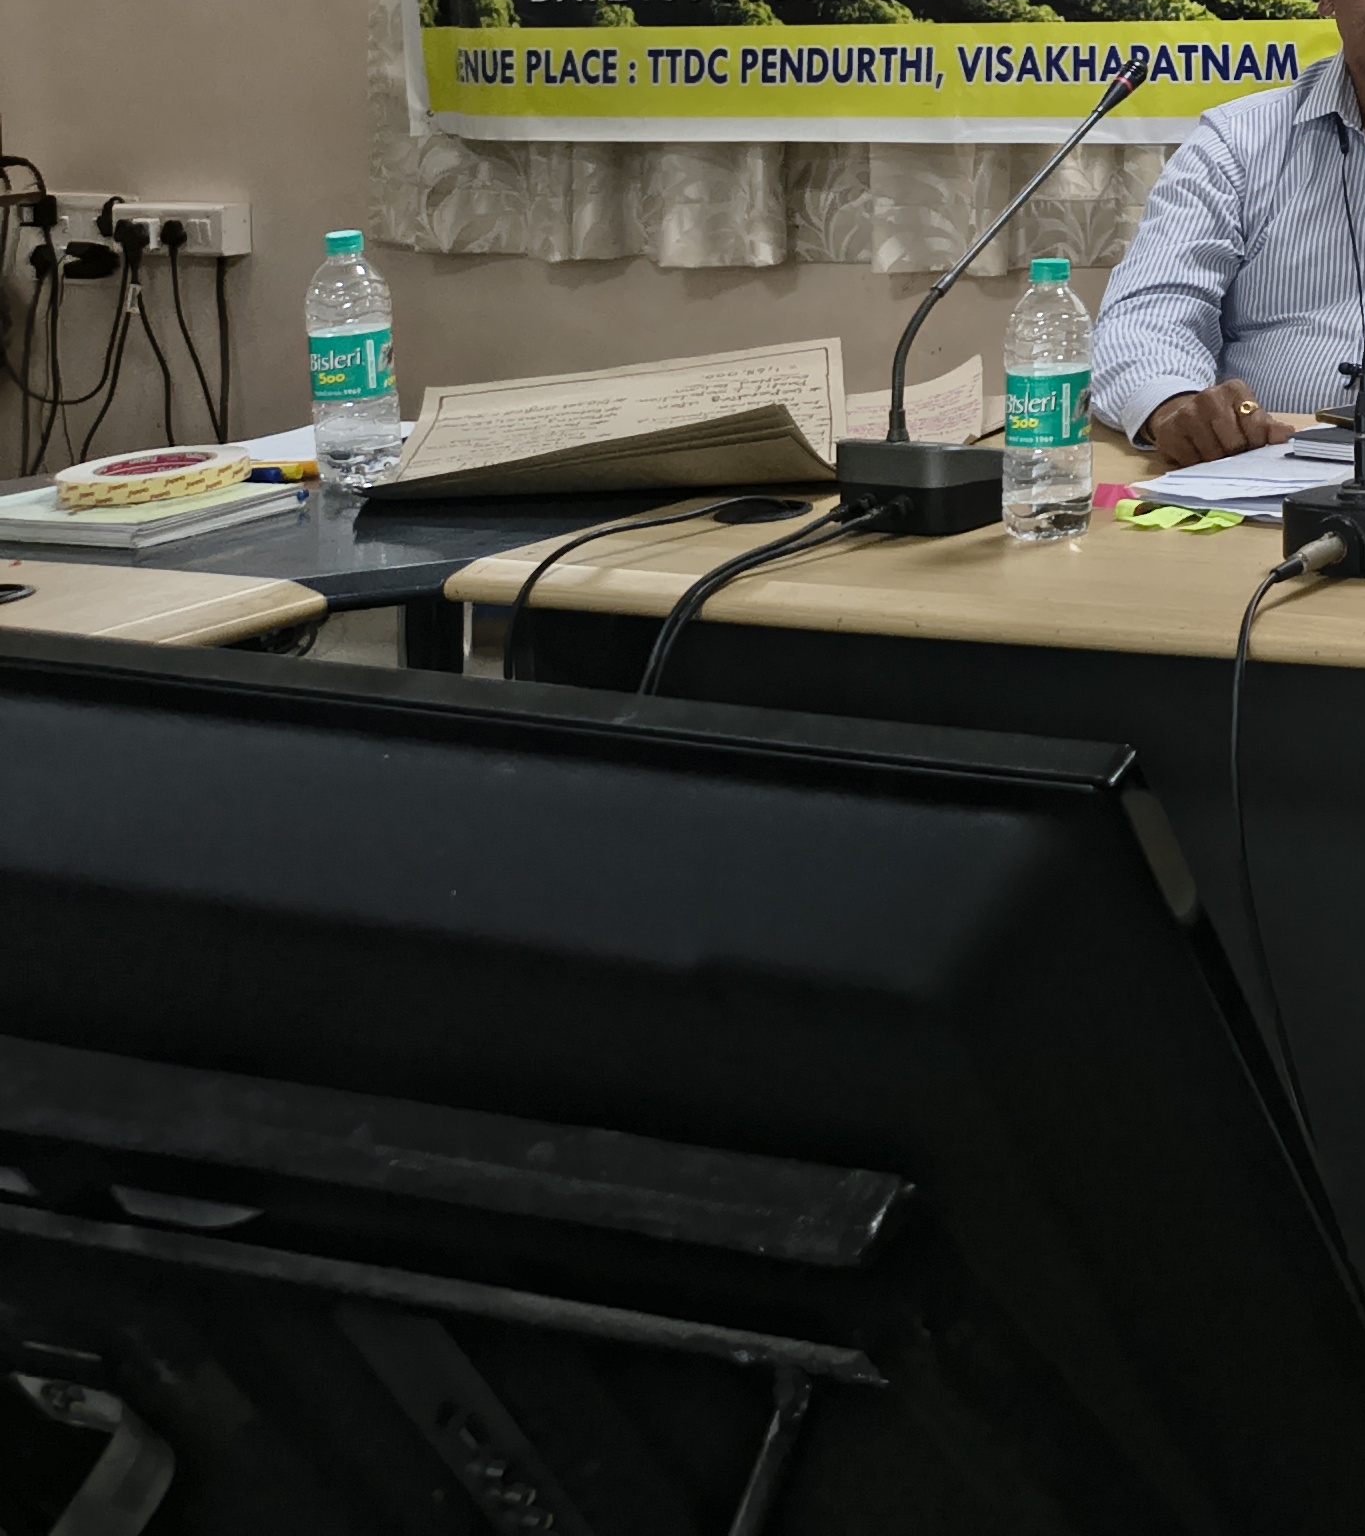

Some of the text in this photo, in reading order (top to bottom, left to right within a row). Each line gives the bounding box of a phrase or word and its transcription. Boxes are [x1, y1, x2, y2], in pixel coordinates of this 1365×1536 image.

[526, 48, 618, 85] PLACE
[648, 47, 729, 85] TTDC
[741, 45, 944, 89] PENDURTHI,
[958, 44, 1299, 85] VISAKHAPATNAM
[310, 347, 362, 371] Bisleri
[319, 373, 346, 385] 500
[1006, 384, 1057, 414] Bisleri
[1012, 416, 1040, 430] 500
